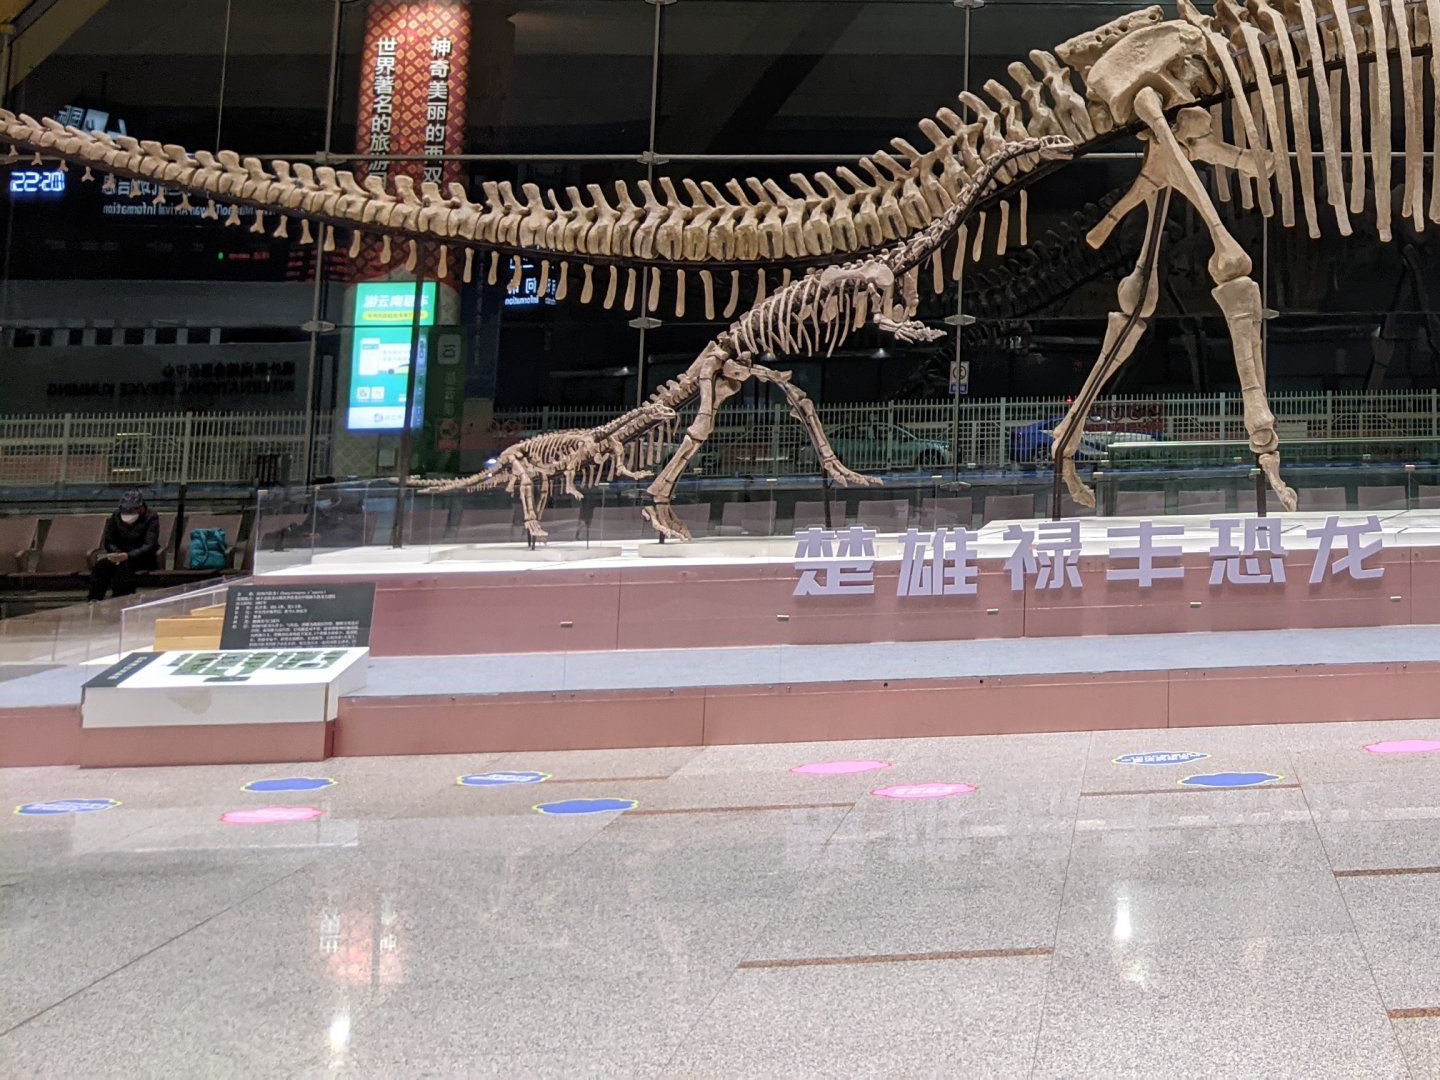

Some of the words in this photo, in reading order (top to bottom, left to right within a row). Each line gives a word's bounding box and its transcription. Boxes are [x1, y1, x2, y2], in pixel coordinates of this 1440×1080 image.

[792, 515, 1386, 597] 楚雄禄丰恐龙
